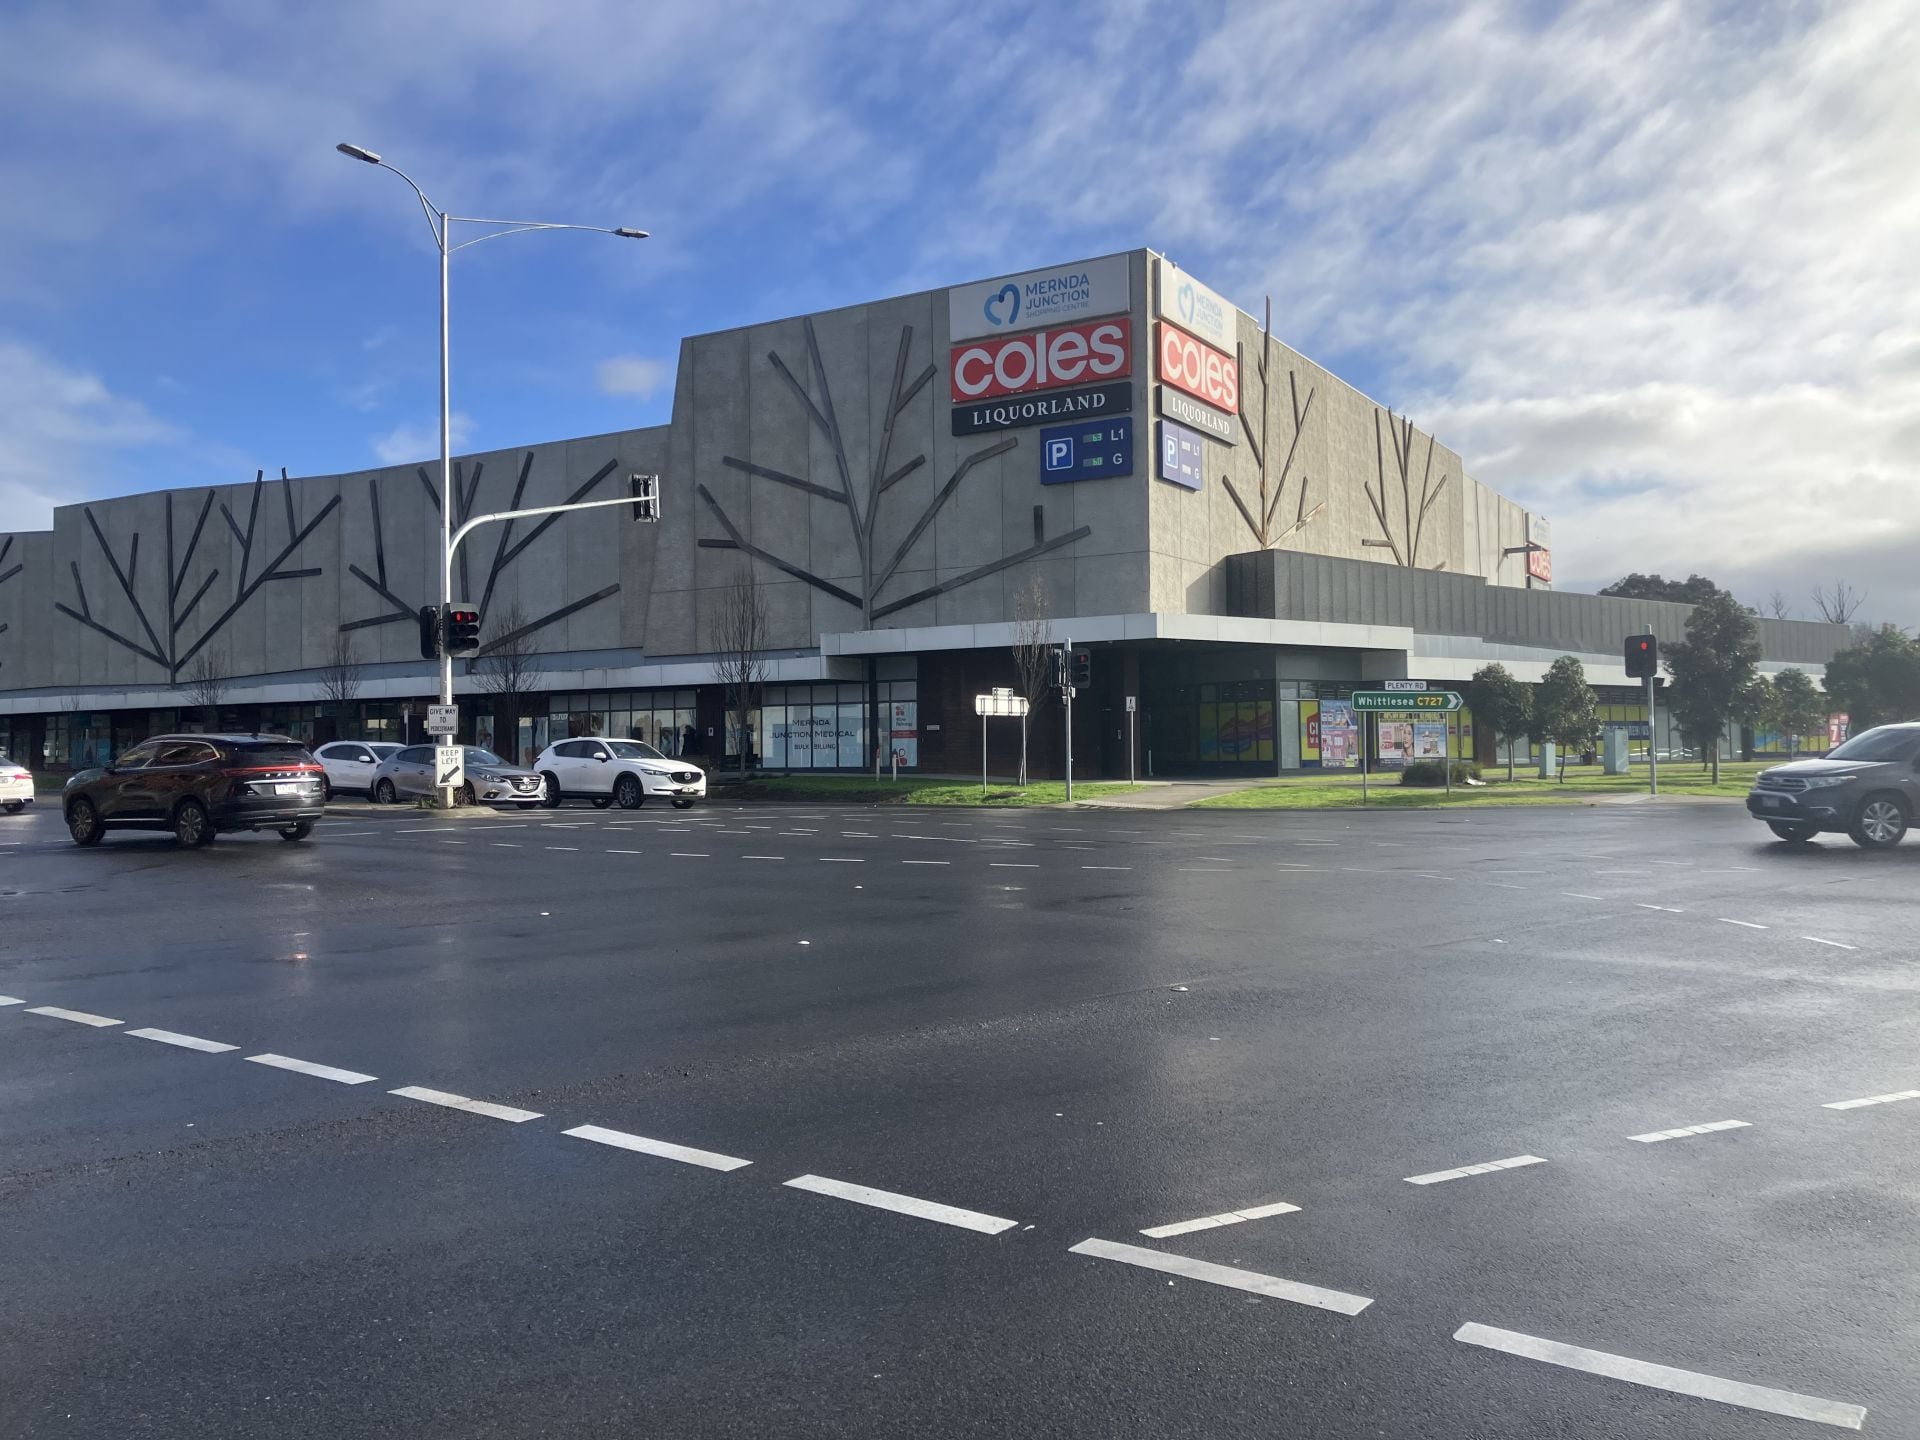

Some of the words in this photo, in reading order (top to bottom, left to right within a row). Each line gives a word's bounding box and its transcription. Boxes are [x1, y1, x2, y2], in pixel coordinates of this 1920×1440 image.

[1025, 273, 1090, 297] MERNDA
[1025, 286, 1090, 310] JUNCTION
[1025, 304, 1061, 319] SHOPPING
[1061, 300, 1089, 314] CENTRE
[954, 324, 1125, 396] coles
[1163, 330, 1237, 408] coles
[972, 393, 1107, 427] LIQUORLAND
[1172, 397, 1230, 435] LIQUORLAND
[1110, 427, 1124, 441] L1
[1052, 443, 1067, 465] P
[1112, 452, 1123, 465] G
[1168, 441, 1177, 463] P
[1387, 682, 1413, 690] PLENTY
[1358, 697, 1414, 706] Whittlesea
[1416, 697, 1443, 706] C727
